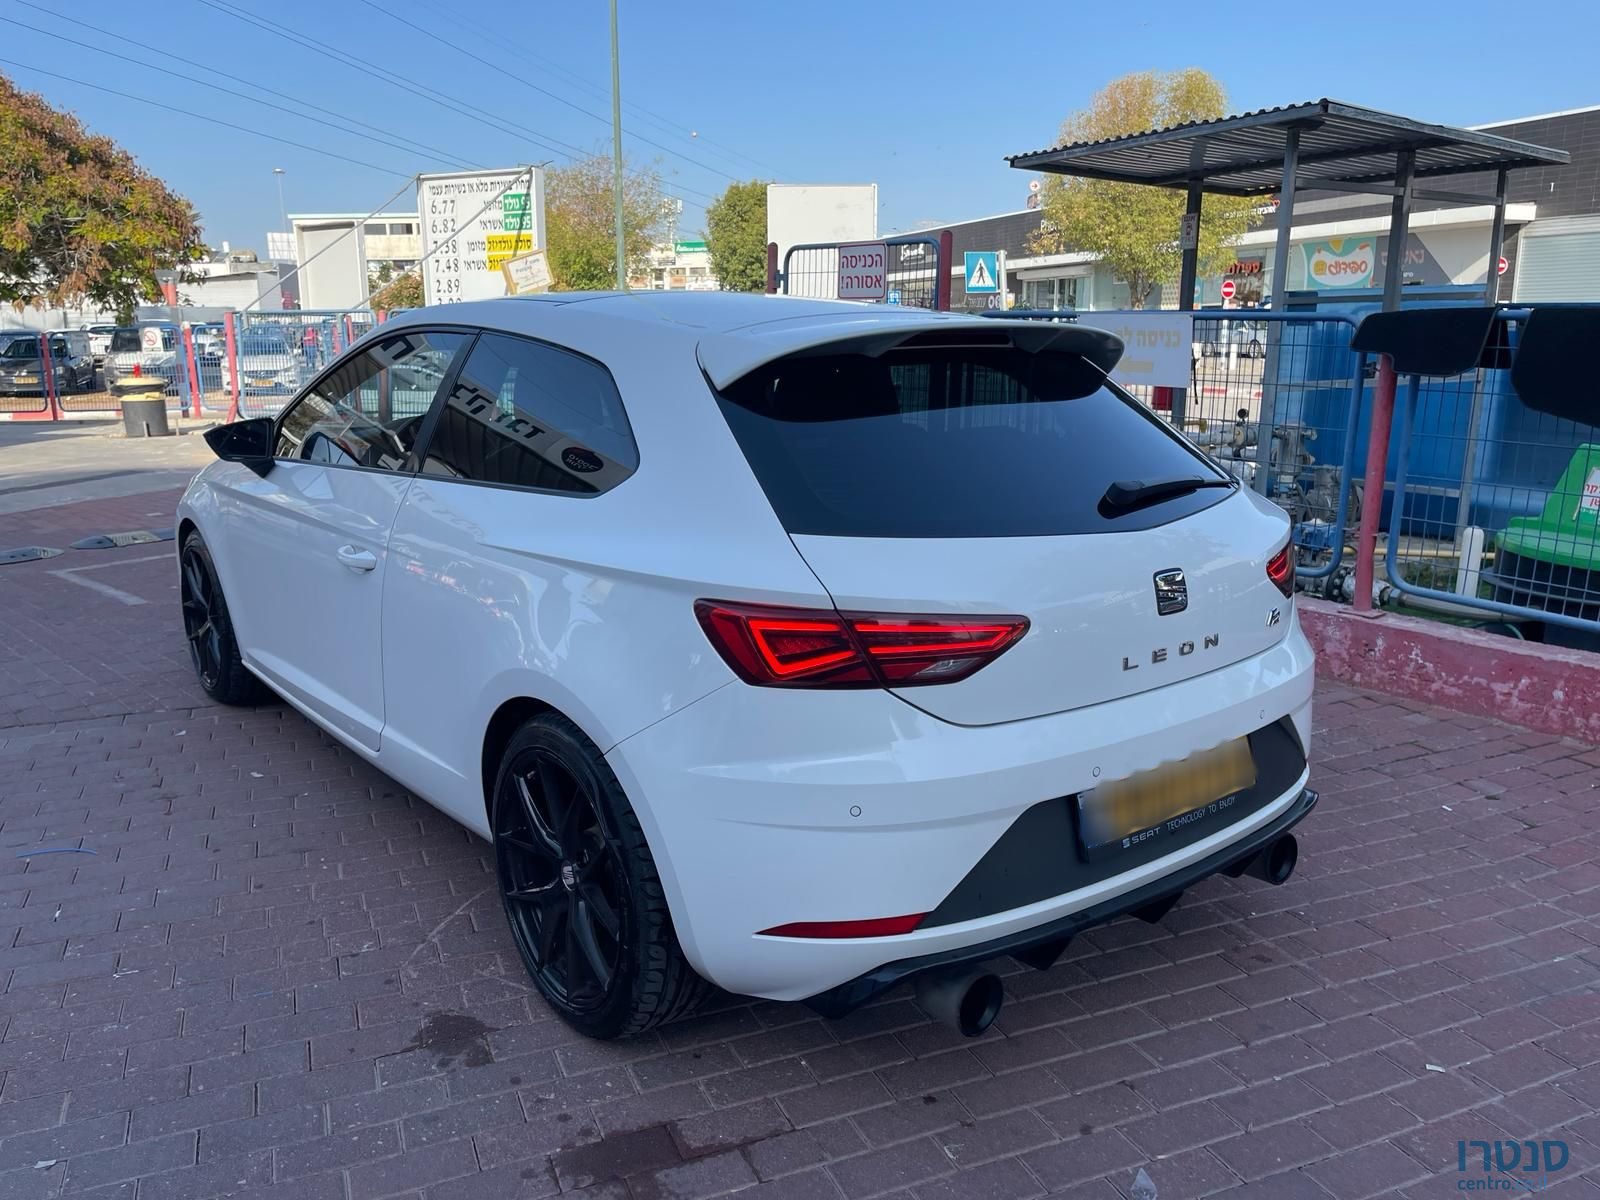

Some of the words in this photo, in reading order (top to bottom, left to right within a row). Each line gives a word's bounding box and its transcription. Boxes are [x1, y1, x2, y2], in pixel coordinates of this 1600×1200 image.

[444, 183, 466, 194] בשירות
[431, 200, 456, 214] 6.77
[431, 219, 456, 233] 6.82
[480, 219, 504, 231] אשראי
[433, 239, 457, 254] 7.38
[467, 240, 486, 254] מזומן
[435, 258, 459, 273] 7.48
[464, 260, 487, 272] אשראי
[841, 253, 883, 269] הכניסה
[436, 279, 460, 293] 2.89
[841, 274, 882, 289] אסורה!
[1136, 330, 1181, 348] כניסה
[1122, 632, 1220, 672] LEON
[1131, 826, 1161, 844] SEAT
[1166, 807, 1206, 831] TECHNOLOGY
[1208, 803, 1217, 815] TO
[1219, 795, 1237, 810] ENJOY
